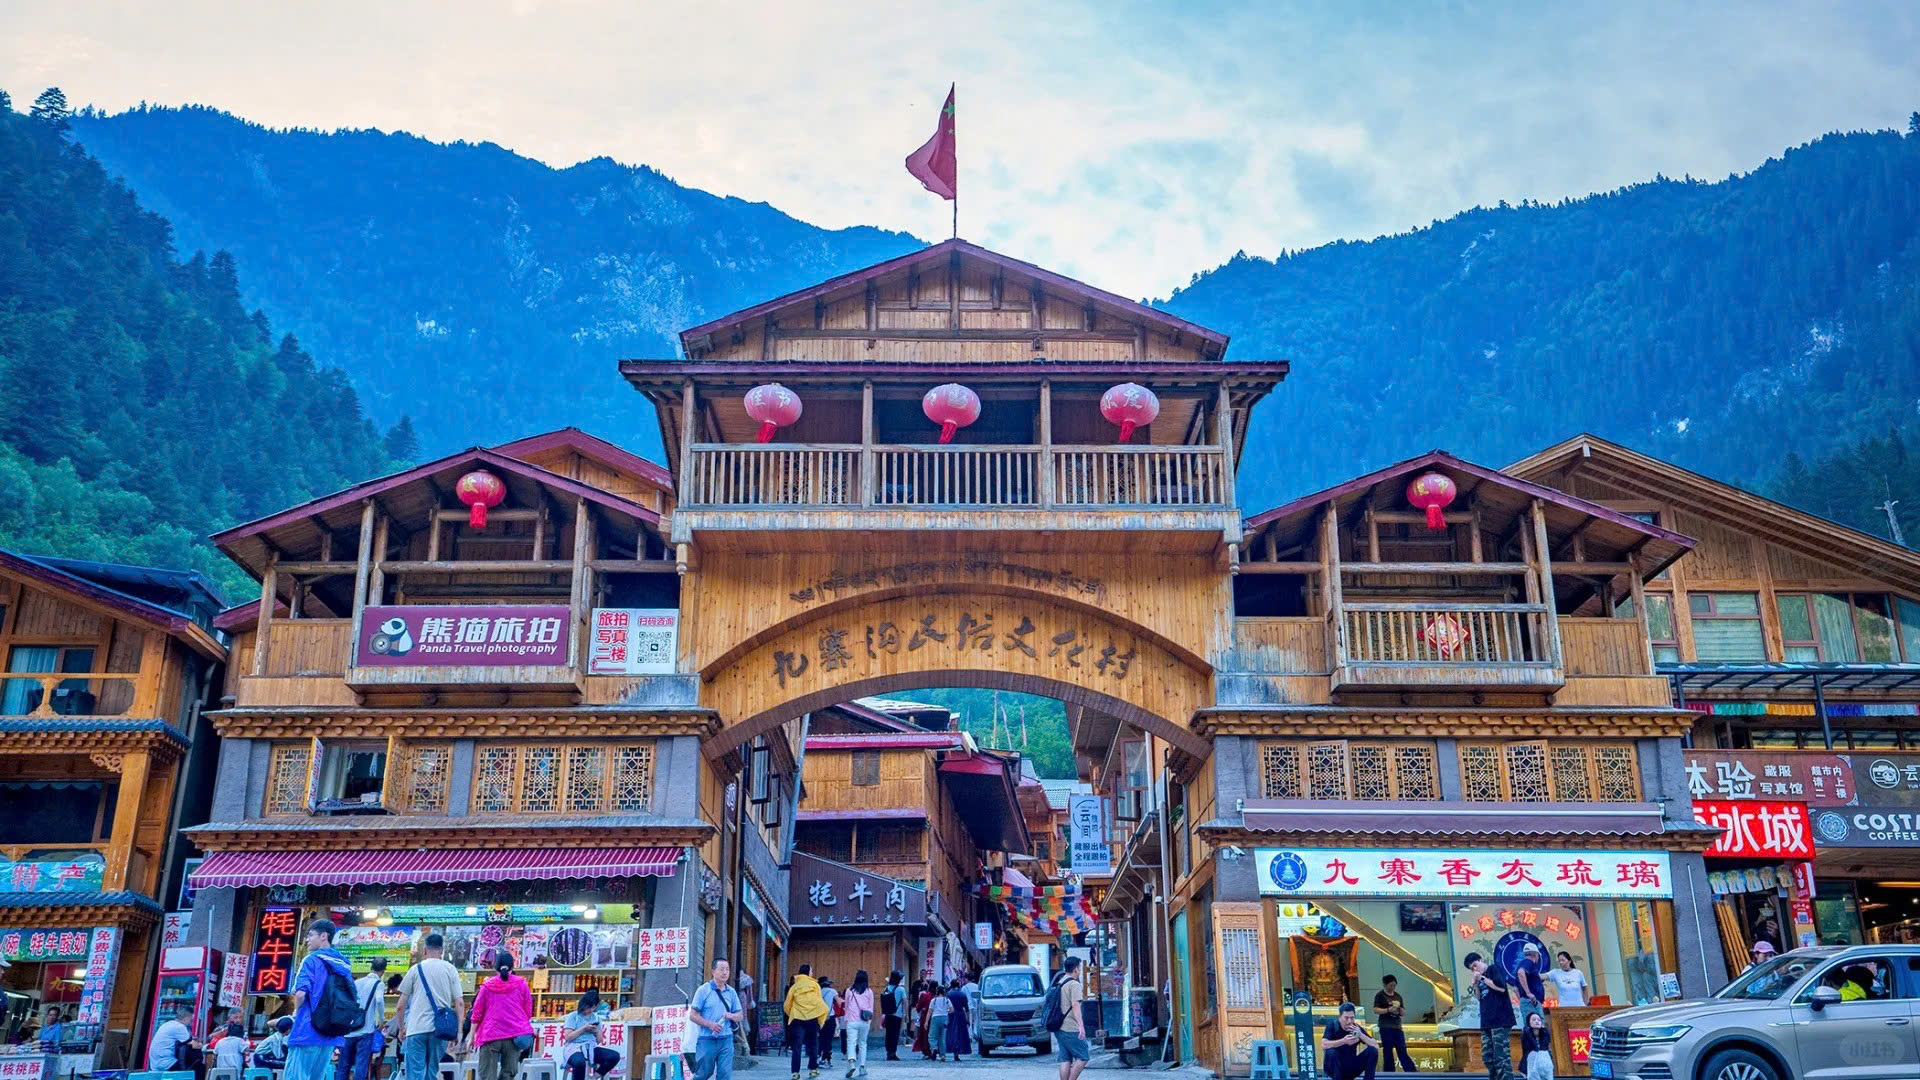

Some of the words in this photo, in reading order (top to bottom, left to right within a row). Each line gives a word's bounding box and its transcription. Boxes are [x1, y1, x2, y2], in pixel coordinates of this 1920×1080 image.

[598, 611, 629, 627] 旅拍
[637, 616, 675, 627] 扫码咨询
[418, 617, 562, 643] 熊猫旅拍
[597, 629, 628, 644] 写真
[419, 644, 452, 653] Panda
[453, 644, 487, 653] Travel
[487, 644, 557, 656] photography
[596, 646, 627, 662] 二楼
[773, 612, 1137, 690] 九寨沟民俗文化村
[1685, 759, 1756, 800] 体验
[1764, 765, 1792, 777] 藏服
[1811, 765, 1842, 777] 超市内
[1760, 782, 1803, 795] 写真馆
[1693, 806, 1808, 853] 冰城
[1853, 814, 1920, 832] COST
[1869, 832, 1918, 841] COFFEE
[1074, 852, 1108, 861] 全程跟拍
[11, 863, 87, 891] 特产
[1322, 858, 1660, 888] 九寨香灰琉璃
[809, 877, 906, 912] 牦牛肉
[164, 916, 180, 948] 天然
[654, 929, 687, 940] 休息区
[30, 932, 87, 956] 牦牛酸奶
[89, 930, 111, 976] 免费品尝
[258, 912, 296, 990] 牦牛肉
[640, 931, 651, 966] 免费
[654, 943, 687, 953] 吸烟区
[653, 956, 687, 967] 开水区
[223, 955, 237, 991] 冰淇淋
[231, 956, 247, 1007] 牦牛酸奶
[2, 1061, 41, 1075] 核桃酥
